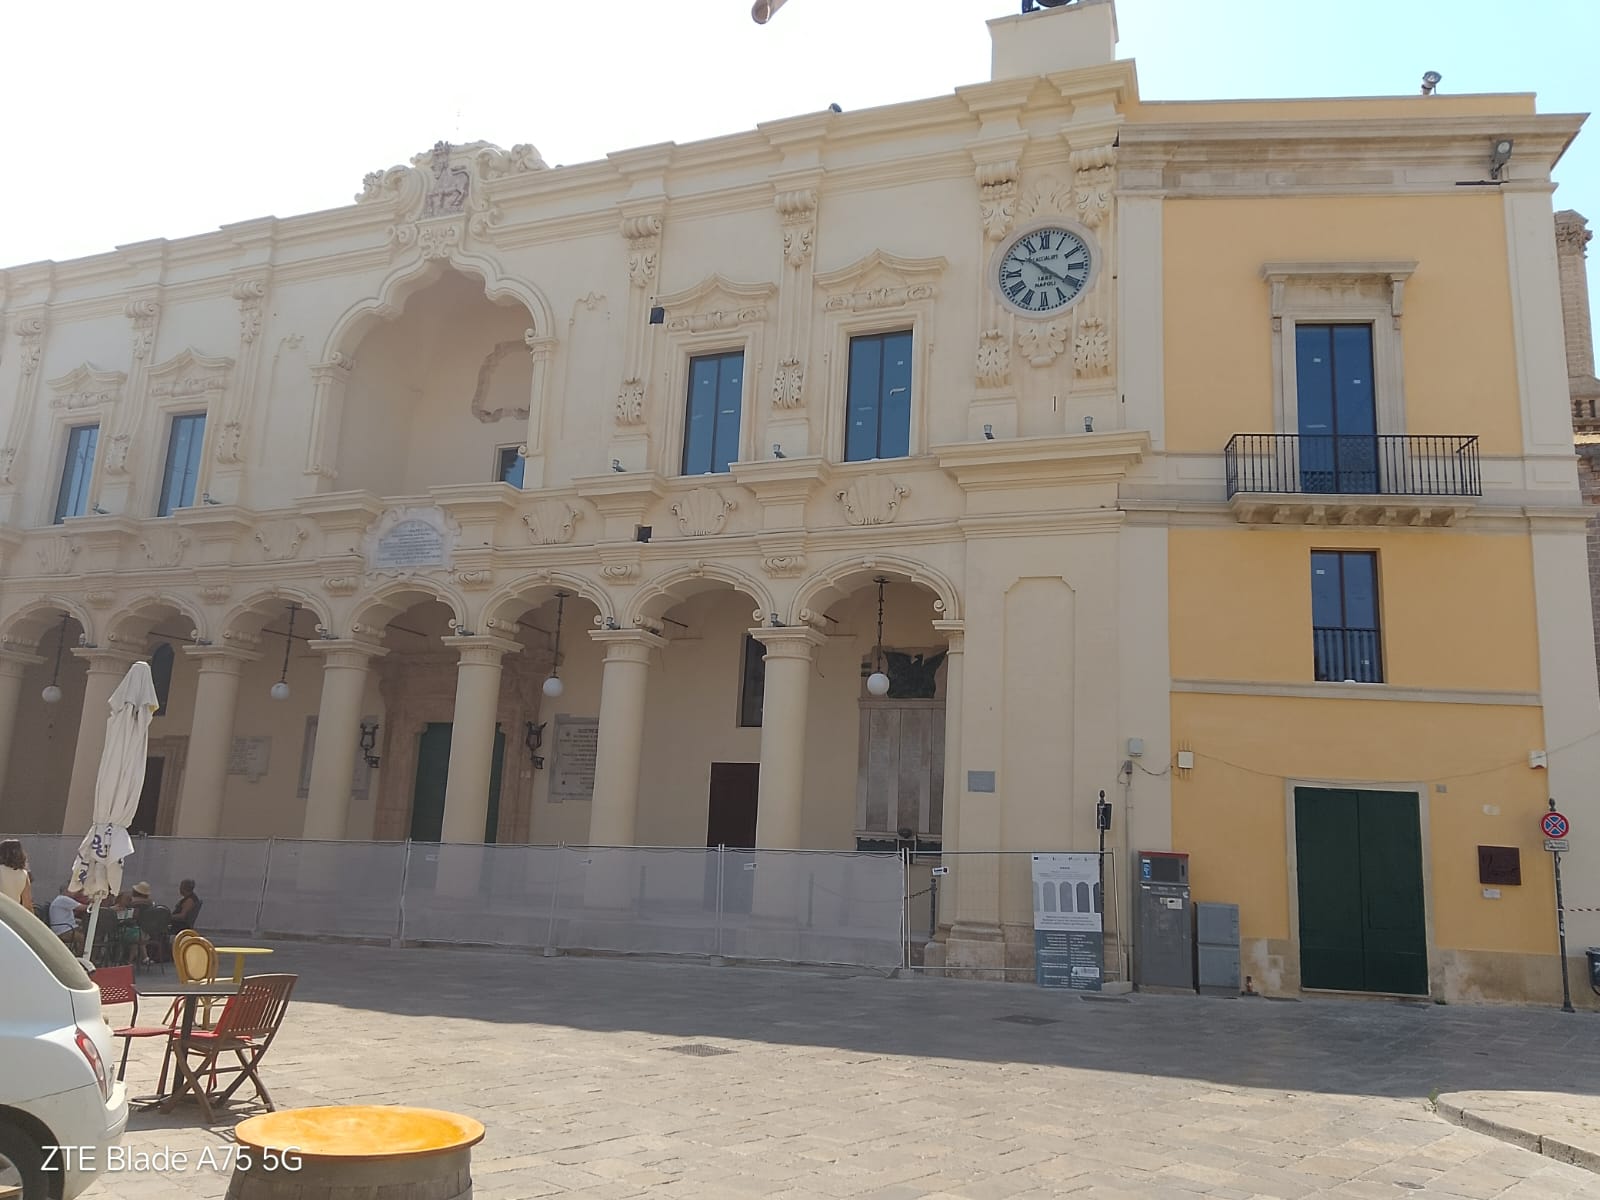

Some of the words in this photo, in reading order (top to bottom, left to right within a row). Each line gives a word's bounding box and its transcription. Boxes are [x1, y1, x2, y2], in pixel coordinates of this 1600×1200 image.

[1023, 240, 1037, 254] XI
[1039, 234, 1050, 250] XII
[1056, 236, 1065, 250] I
[1064, 246, 1080, 258] II
[1067, 262, 1084, 271] III
[1006, 268, 1022, 279] IX
[1056, 287, 1066, 300] V
